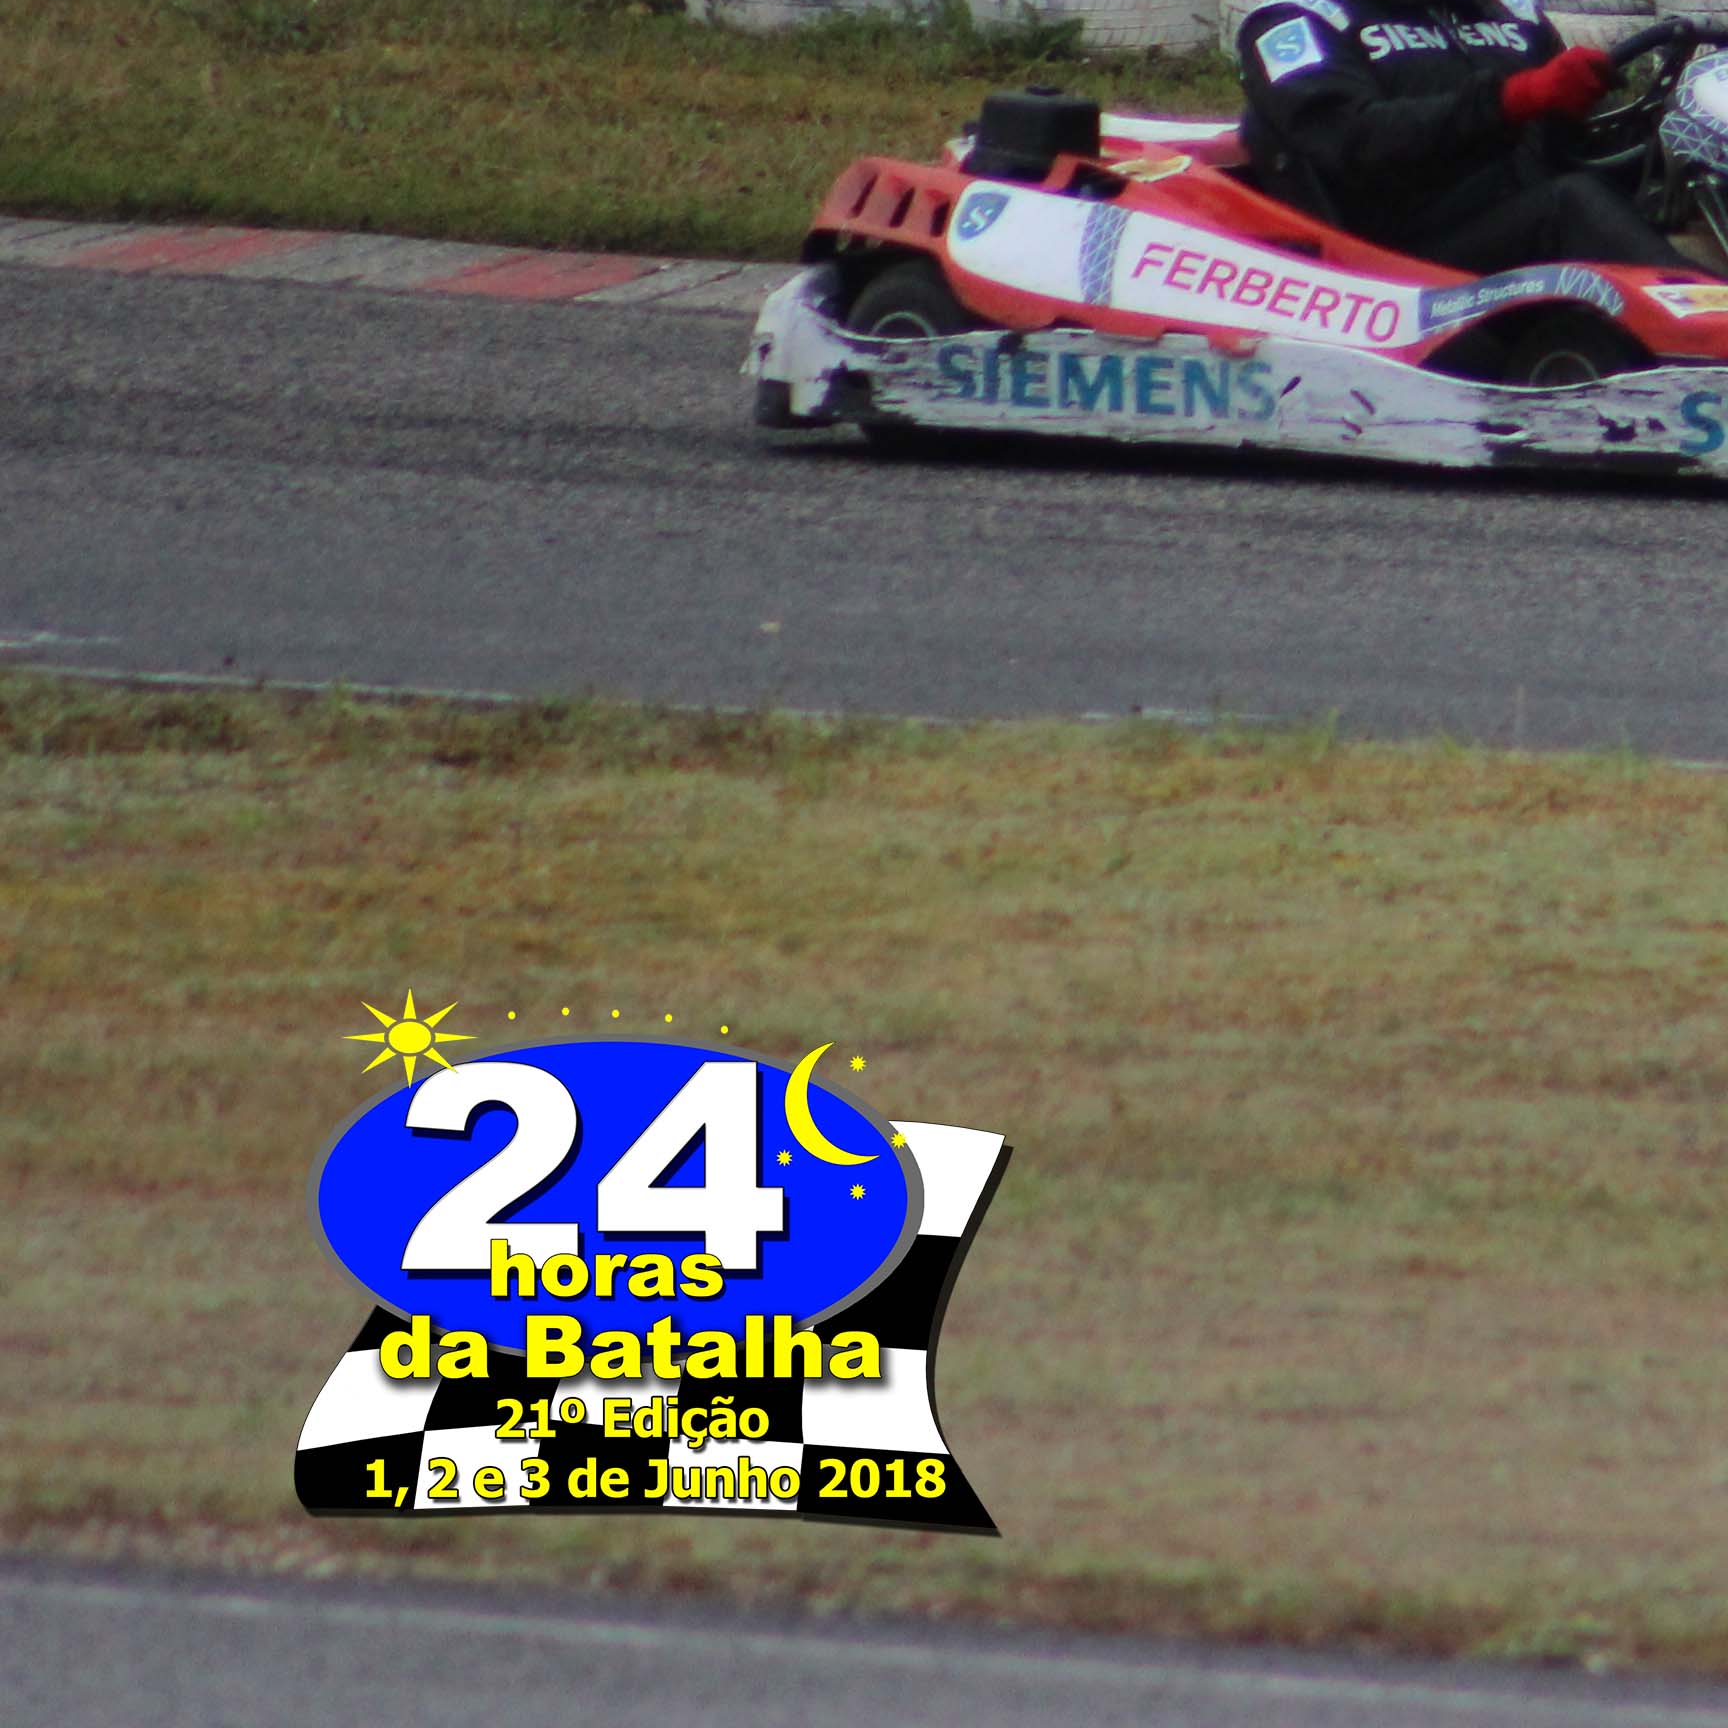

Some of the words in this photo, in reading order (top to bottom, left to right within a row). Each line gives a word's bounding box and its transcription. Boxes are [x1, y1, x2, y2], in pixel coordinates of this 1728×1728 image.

[1129, 242, 1402, 344] FERBERTO
[1477, 279, 1546, 306] Structures
[935, 342, 1276, 422] SIEMENS
